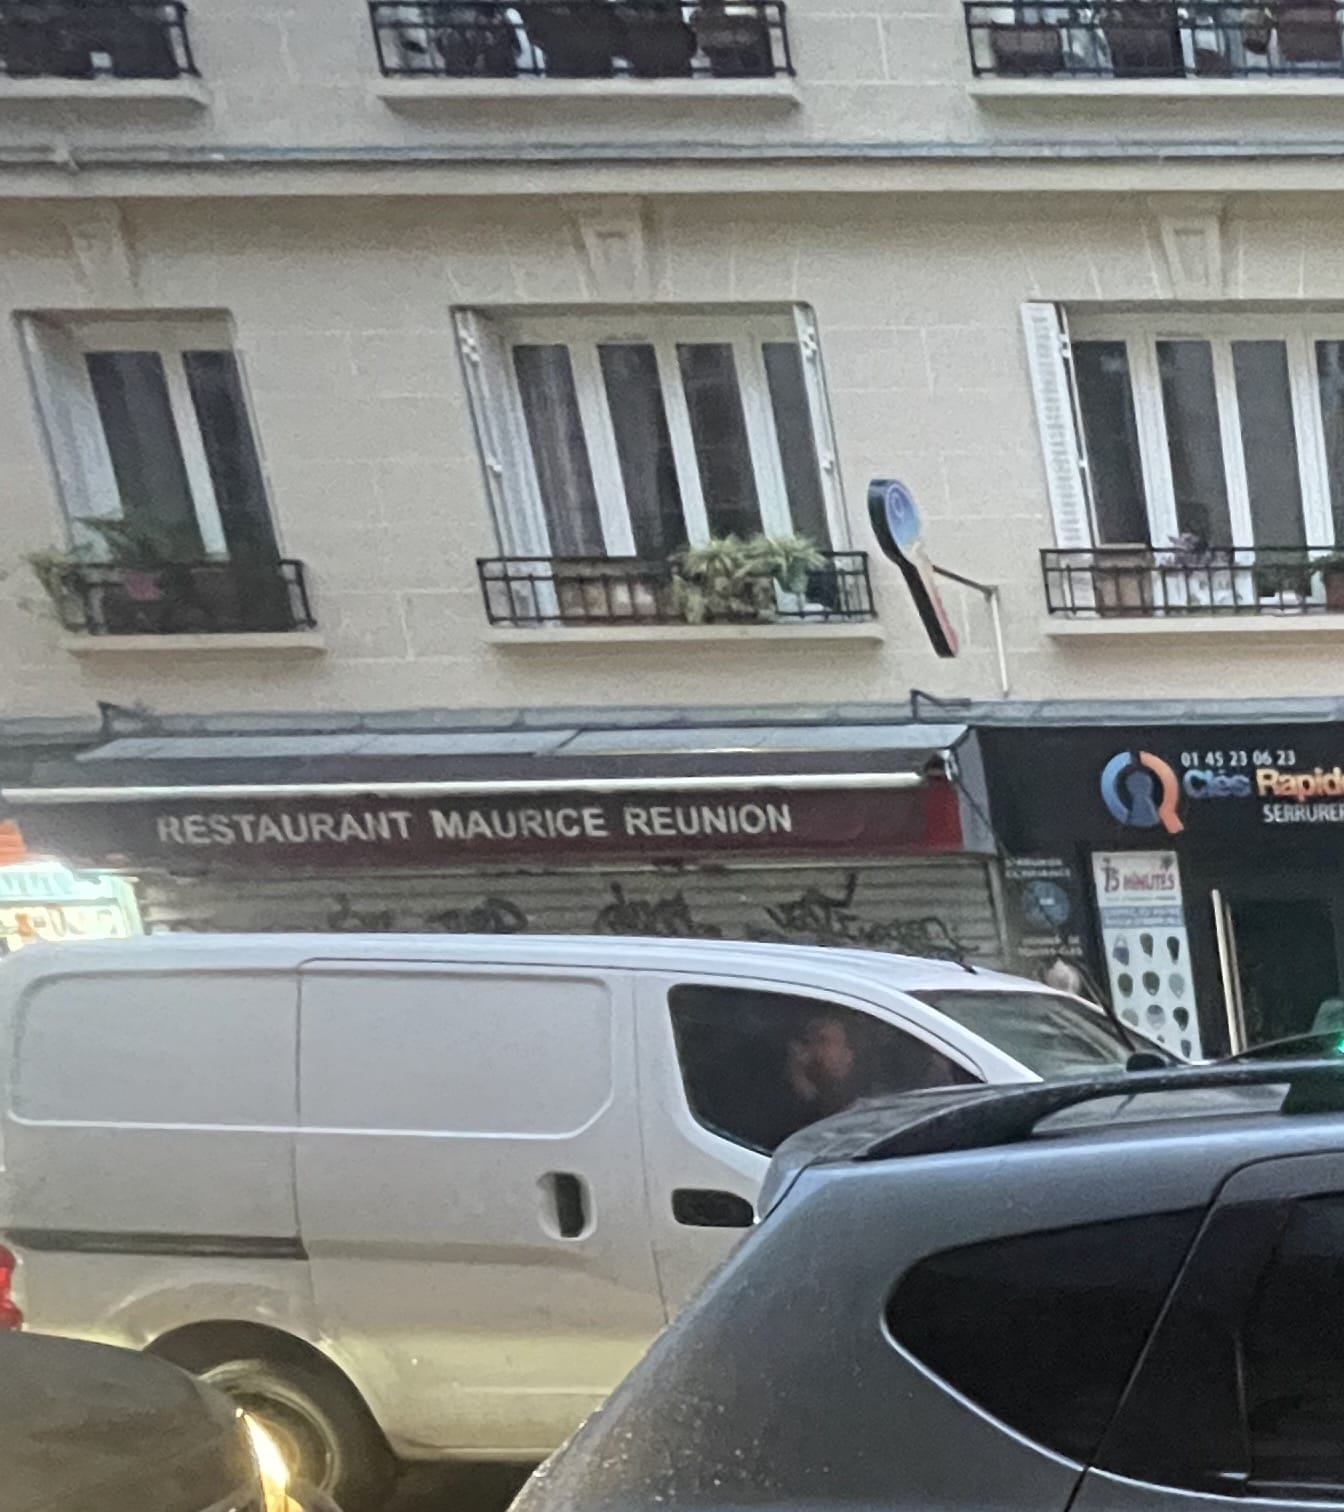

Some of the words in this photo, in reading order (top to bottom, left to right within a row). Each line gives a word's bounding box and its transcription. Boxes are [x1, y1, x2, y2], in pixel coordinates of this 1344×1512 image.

[1181, 752, 1199, 766] 01
[1205, 751, 1224, 766] 45
[1229, 751, 1248, 766] 23
[1277, 750, 1296, 766] 23
[156, 808, 412, 847] RESTAURANT
[431, 804, 609, 841] MAURICE
[624, 800, 794, 837] REUNION
